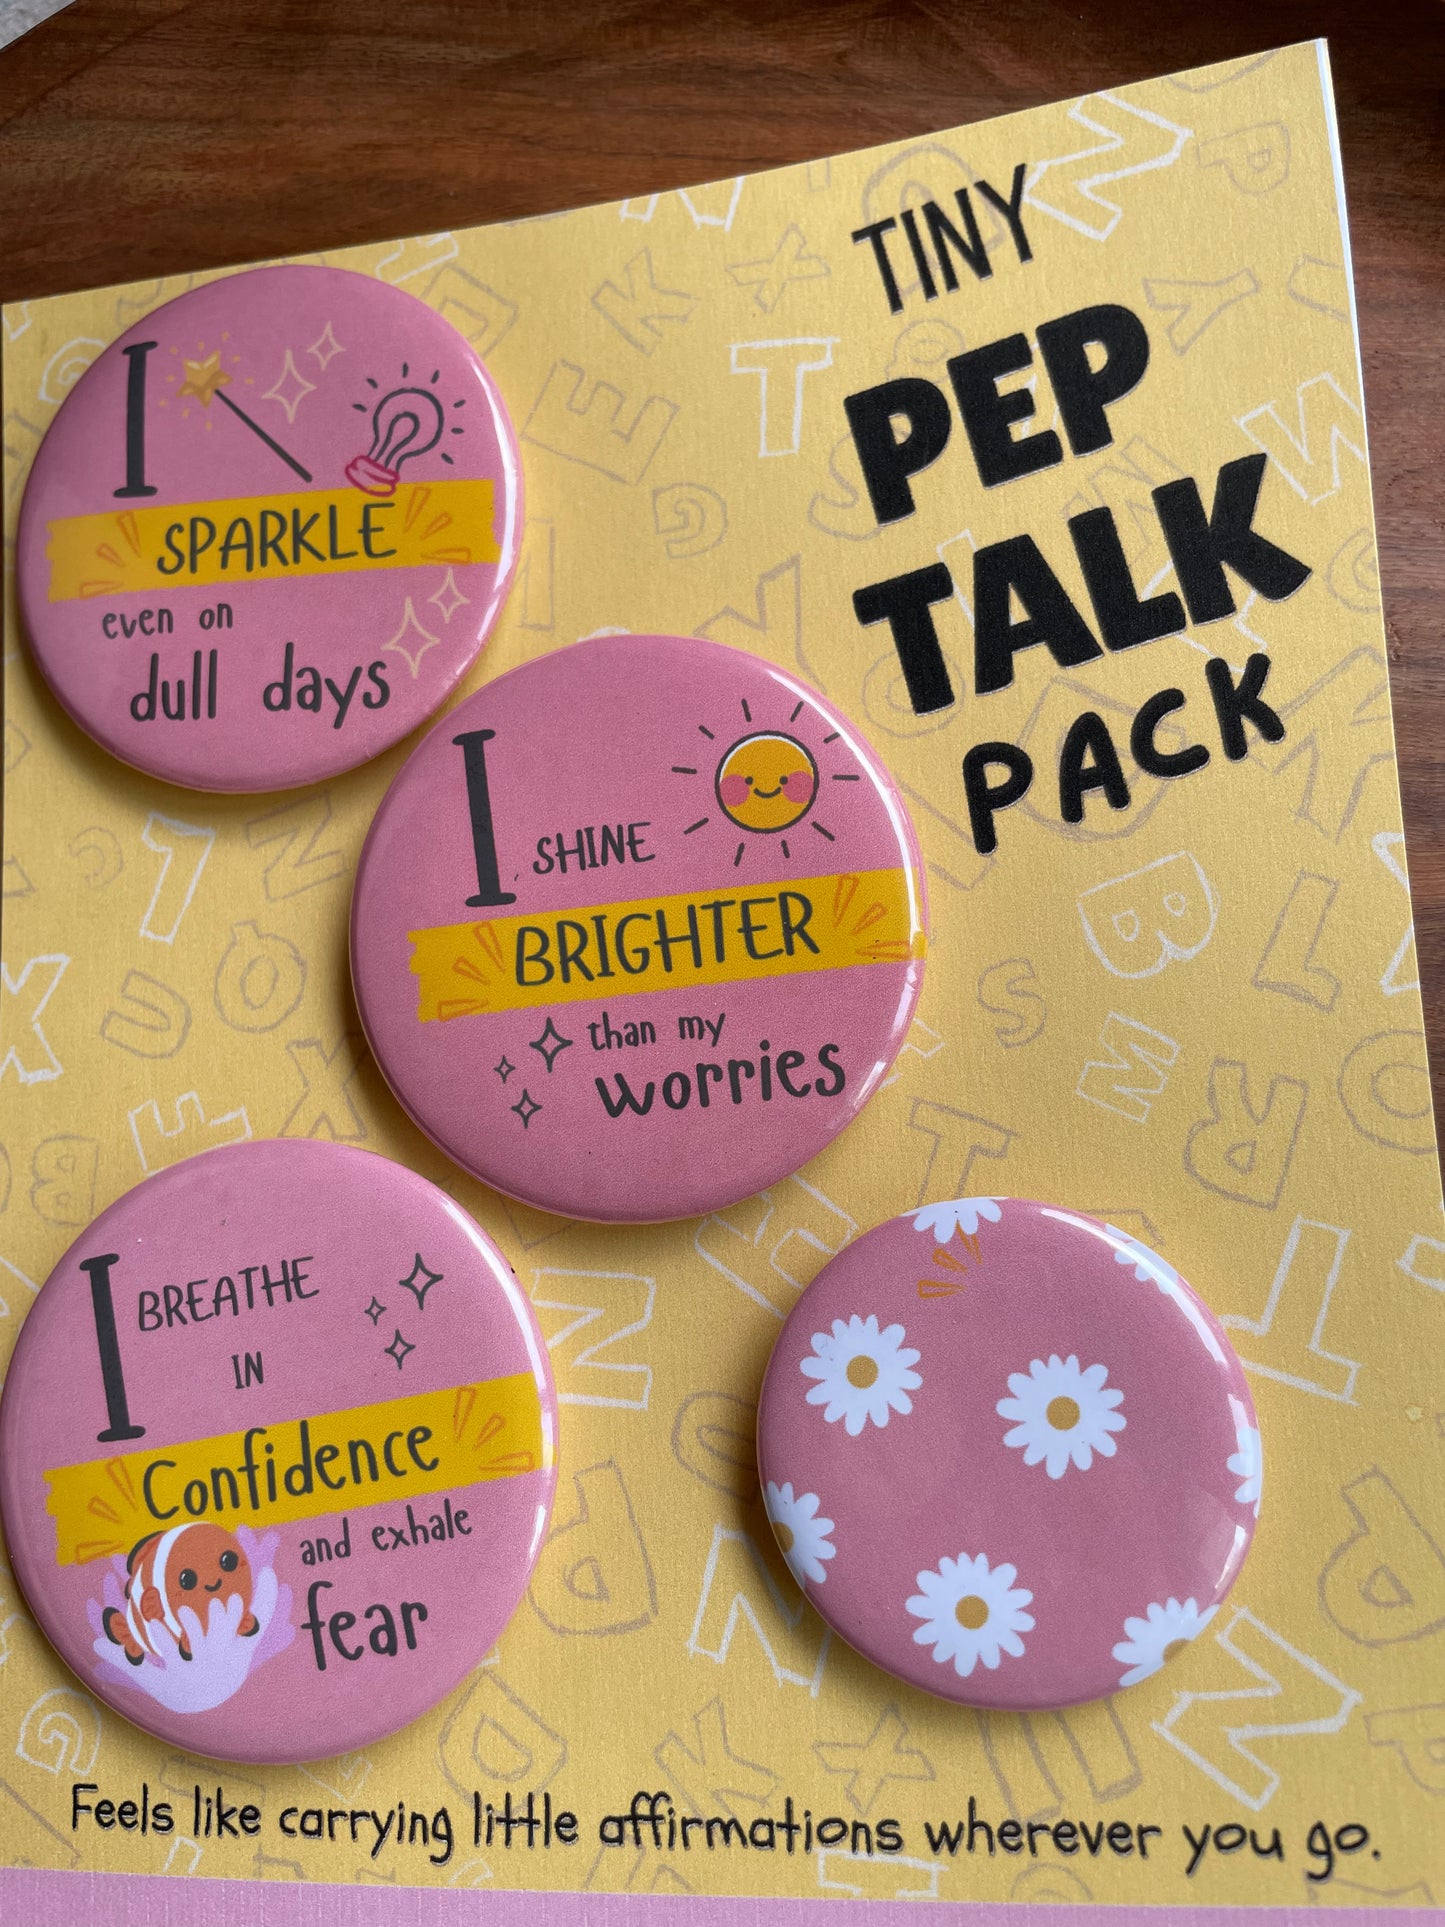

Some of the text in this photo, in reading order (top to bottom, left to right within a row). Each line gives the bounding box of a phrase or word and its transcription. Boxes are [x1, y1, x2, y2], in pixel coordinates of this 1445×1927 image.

[852, 163, 1033, 312] TINY
[113, 340, 158, 498] I
[844, 304, 1150, 524] PEP
[157, 503, 396, 574] SPARKLE
[852, 452, 1312, 716] TALK
[102, 603, 233, 639] even on
[130, 642, 390, 730] dull days
[962, 653, 1285, 855] PACK
[452, 729, 656, 908] I SHINE
[514, 891, 820, 986] BRIGHTER
[587, 1011, 726, 1051] than my
[594, 1040, 847, 1118] worries
[79, 1253, 320, 1442] I BREATHE
[231, 1351, 264, 1389] IN
[142, 1420, 440, 1521] Confidence
[300, 1498, 472, 1566] and exhale
[301, 1581, 428, 1671] fear
[71, 1782, 1380, 1882] Feels like carrying little affirmations wherever you go.
